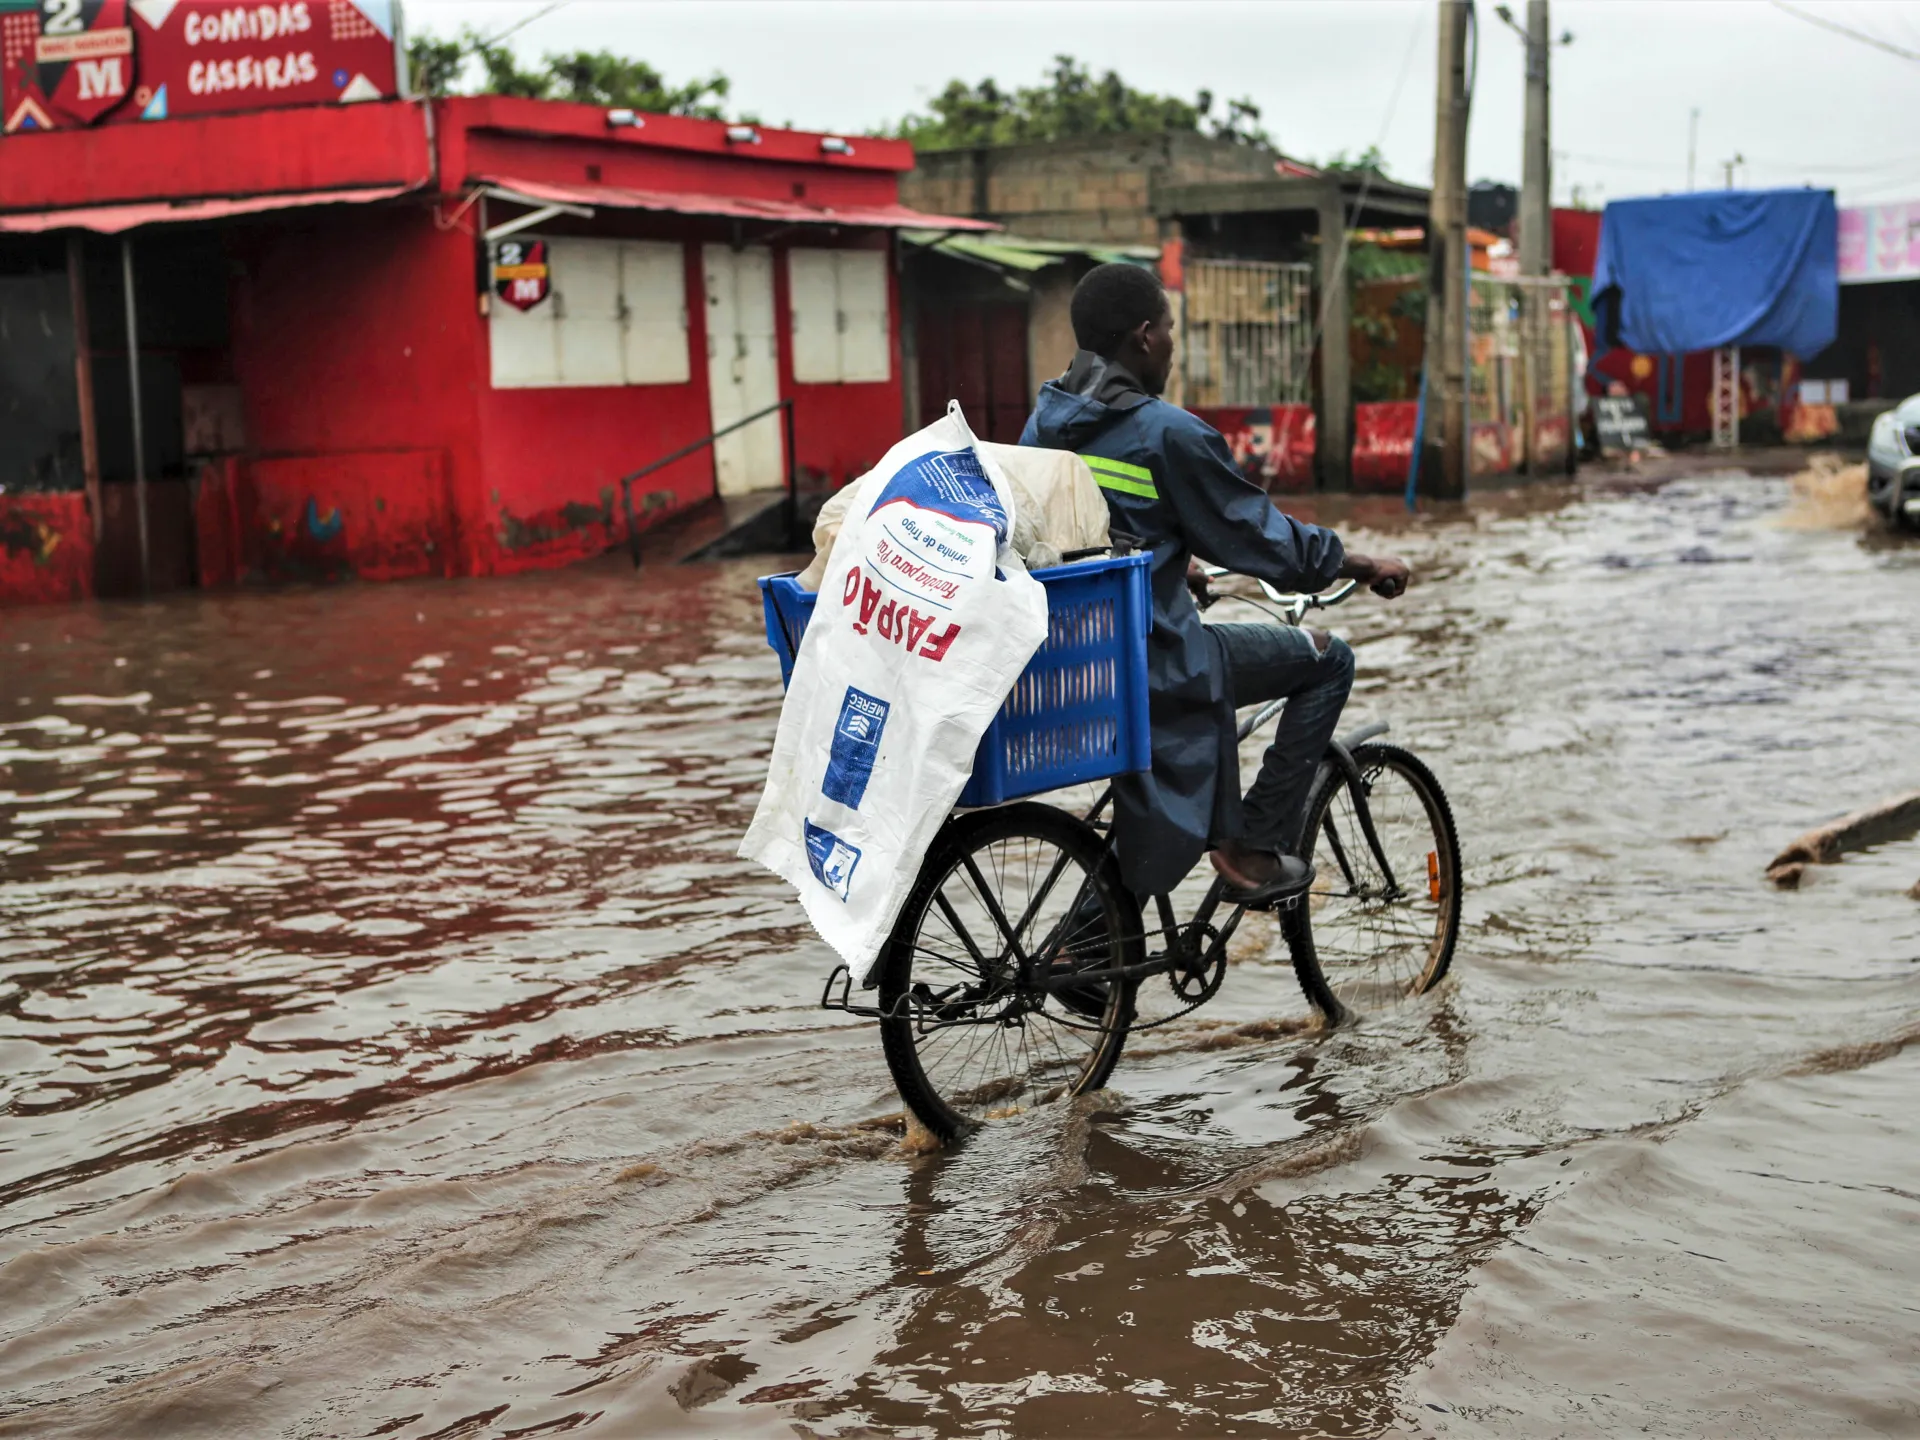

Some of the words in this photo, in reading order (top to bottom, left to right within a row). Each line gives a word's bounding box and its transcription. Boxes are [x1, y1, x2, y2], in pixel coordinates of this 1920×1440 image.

[44, 0, 83, 34] 2
[184, 1, 312, 46] COMIDAS
[76, 58, 124, 100] M
[187, 51, 318, 95] CASEIRAS
[500, 243, 522, 265] 2
[514, 278, 539, 300] M
[901, 517, 923, 541] Trigo
[922, 534, 936, 548] de
[890, 554, 925, 579] para
[914, 571, 960, 600] Farinha
[842, 565, 962, 663] FASPÃO
[849, 693, 886, 717] MEREC
